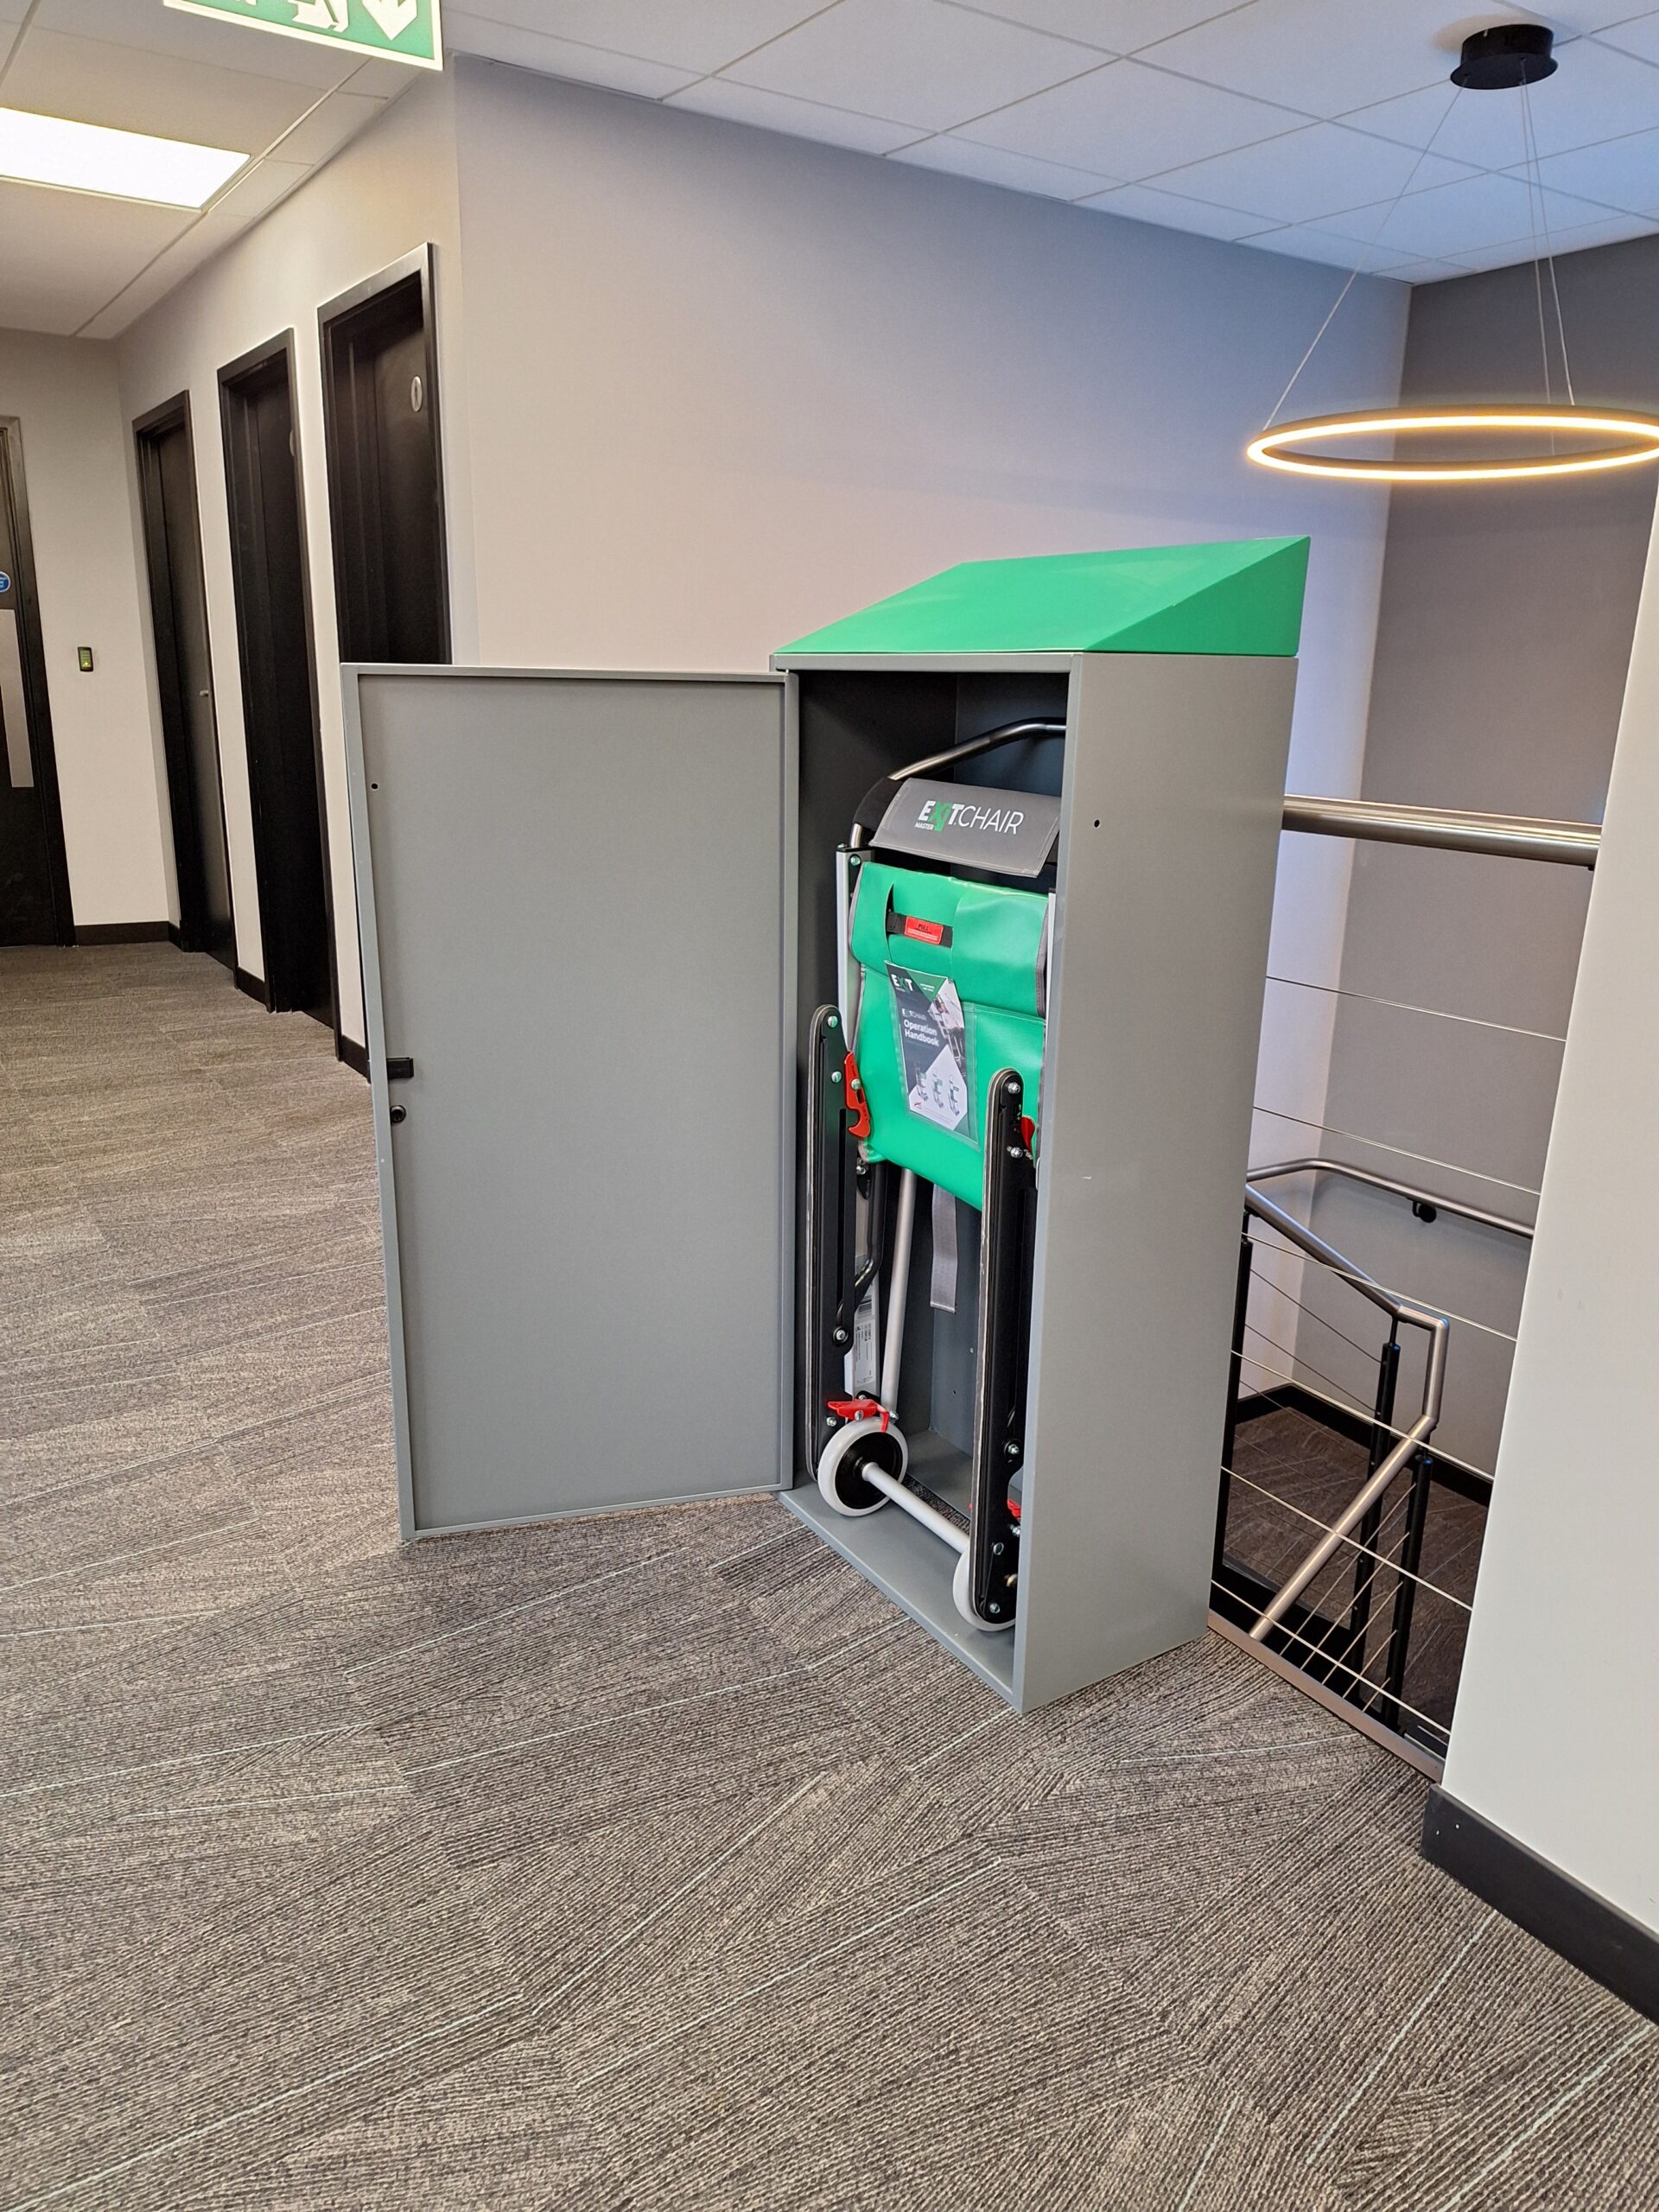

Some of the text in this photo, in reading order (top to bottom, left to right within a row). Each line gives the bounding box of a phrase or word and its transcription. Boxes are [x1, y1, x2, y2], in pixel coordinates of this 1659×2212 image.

[915, 822, 934, 830] MASTER
[904, 1020, 938, 1036] Operation
[905, 1029, 939, 1046] Handbook
